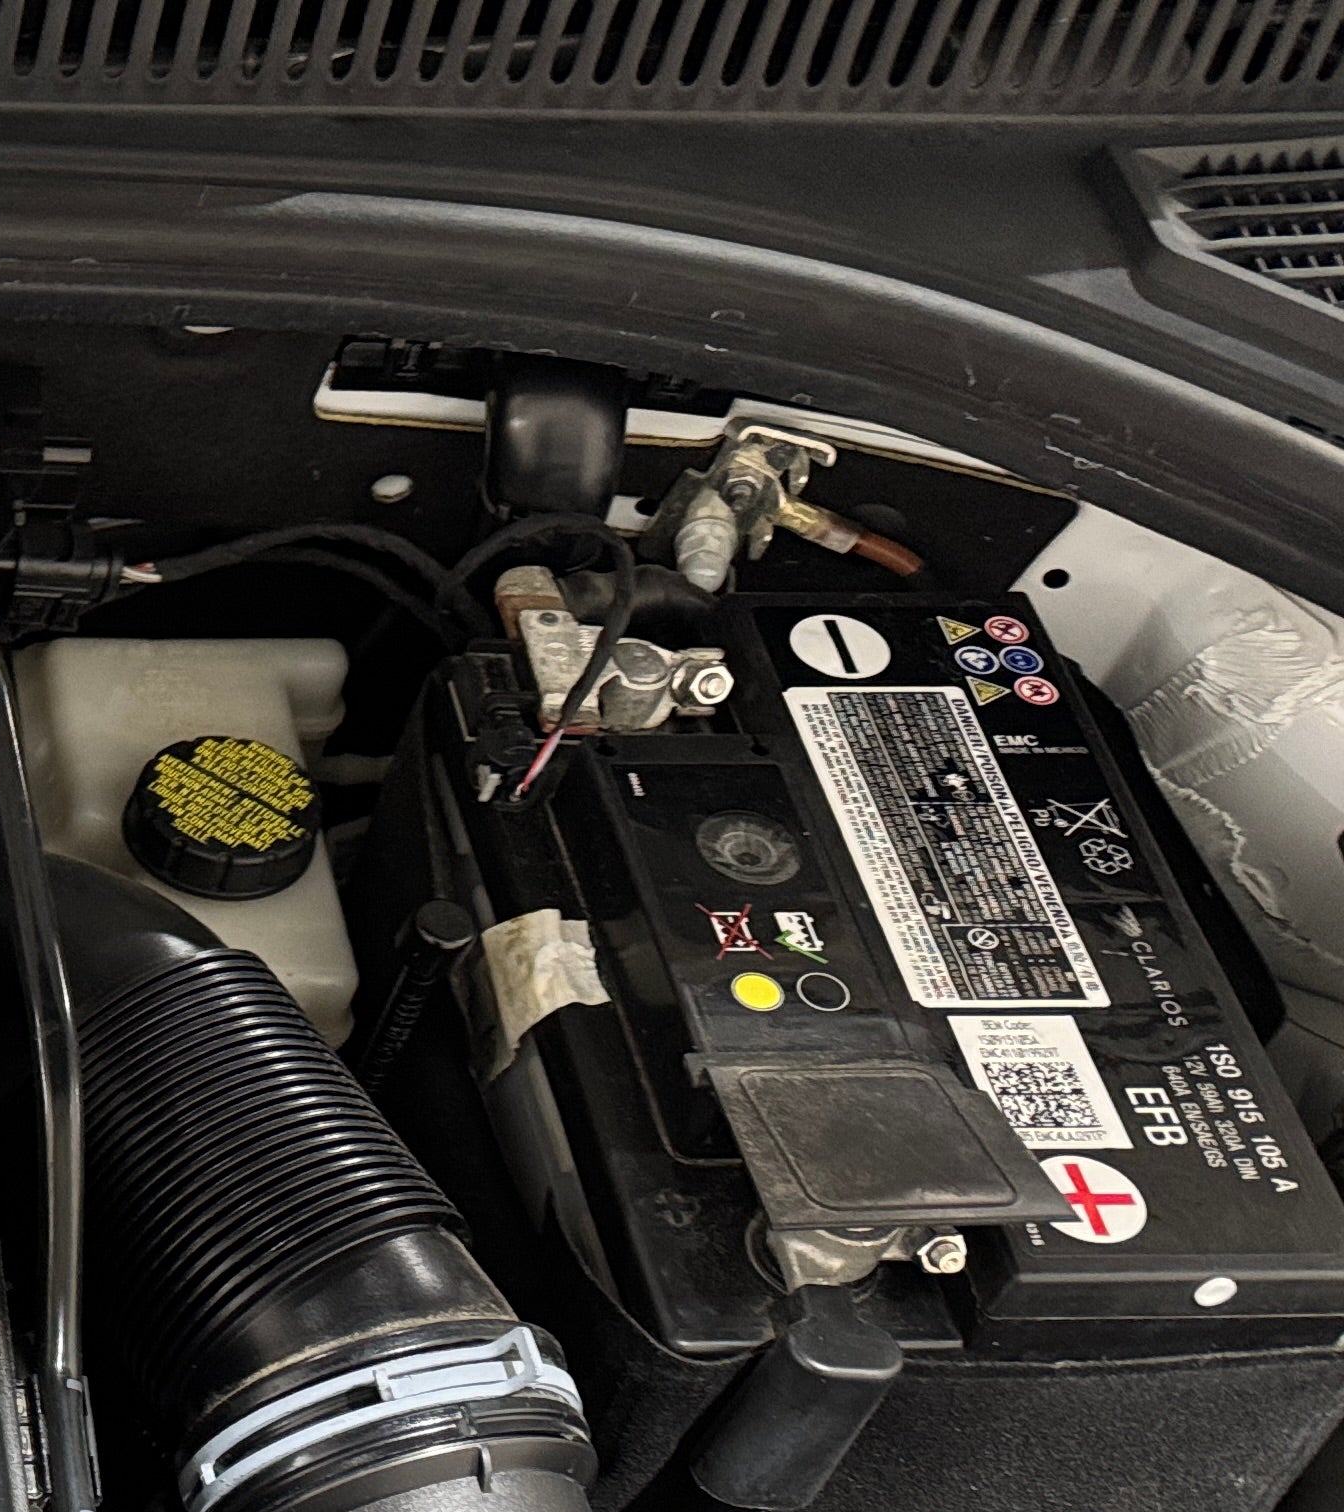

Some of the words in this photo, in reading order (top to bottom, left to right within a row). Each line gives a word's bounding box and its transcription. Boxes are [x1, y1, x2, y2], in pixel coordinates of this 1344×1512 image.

[993, 735, 1040, 747] EMC
[1131, 940, 1189, 1028] CLARIOS
[1182, 1056, 1210, 1078] 12V
[1195, 1083, 1226, 1113] 59Ah
[1124, 1087, 1189, 1147] EFB
[1162, 1065, 1192, 1097] 640A
[1179, 1102, 1228, 1168] EN/SAE/GS
[1214, 1119, 1246, 1152] 320A
[1227, 1088, 1267, 1124] 915
[1251, 1134, 1288, 1170] 105
[1270, 1177, 1299, 1193] A
[1233, 1157, 1261, 1181] DIN
